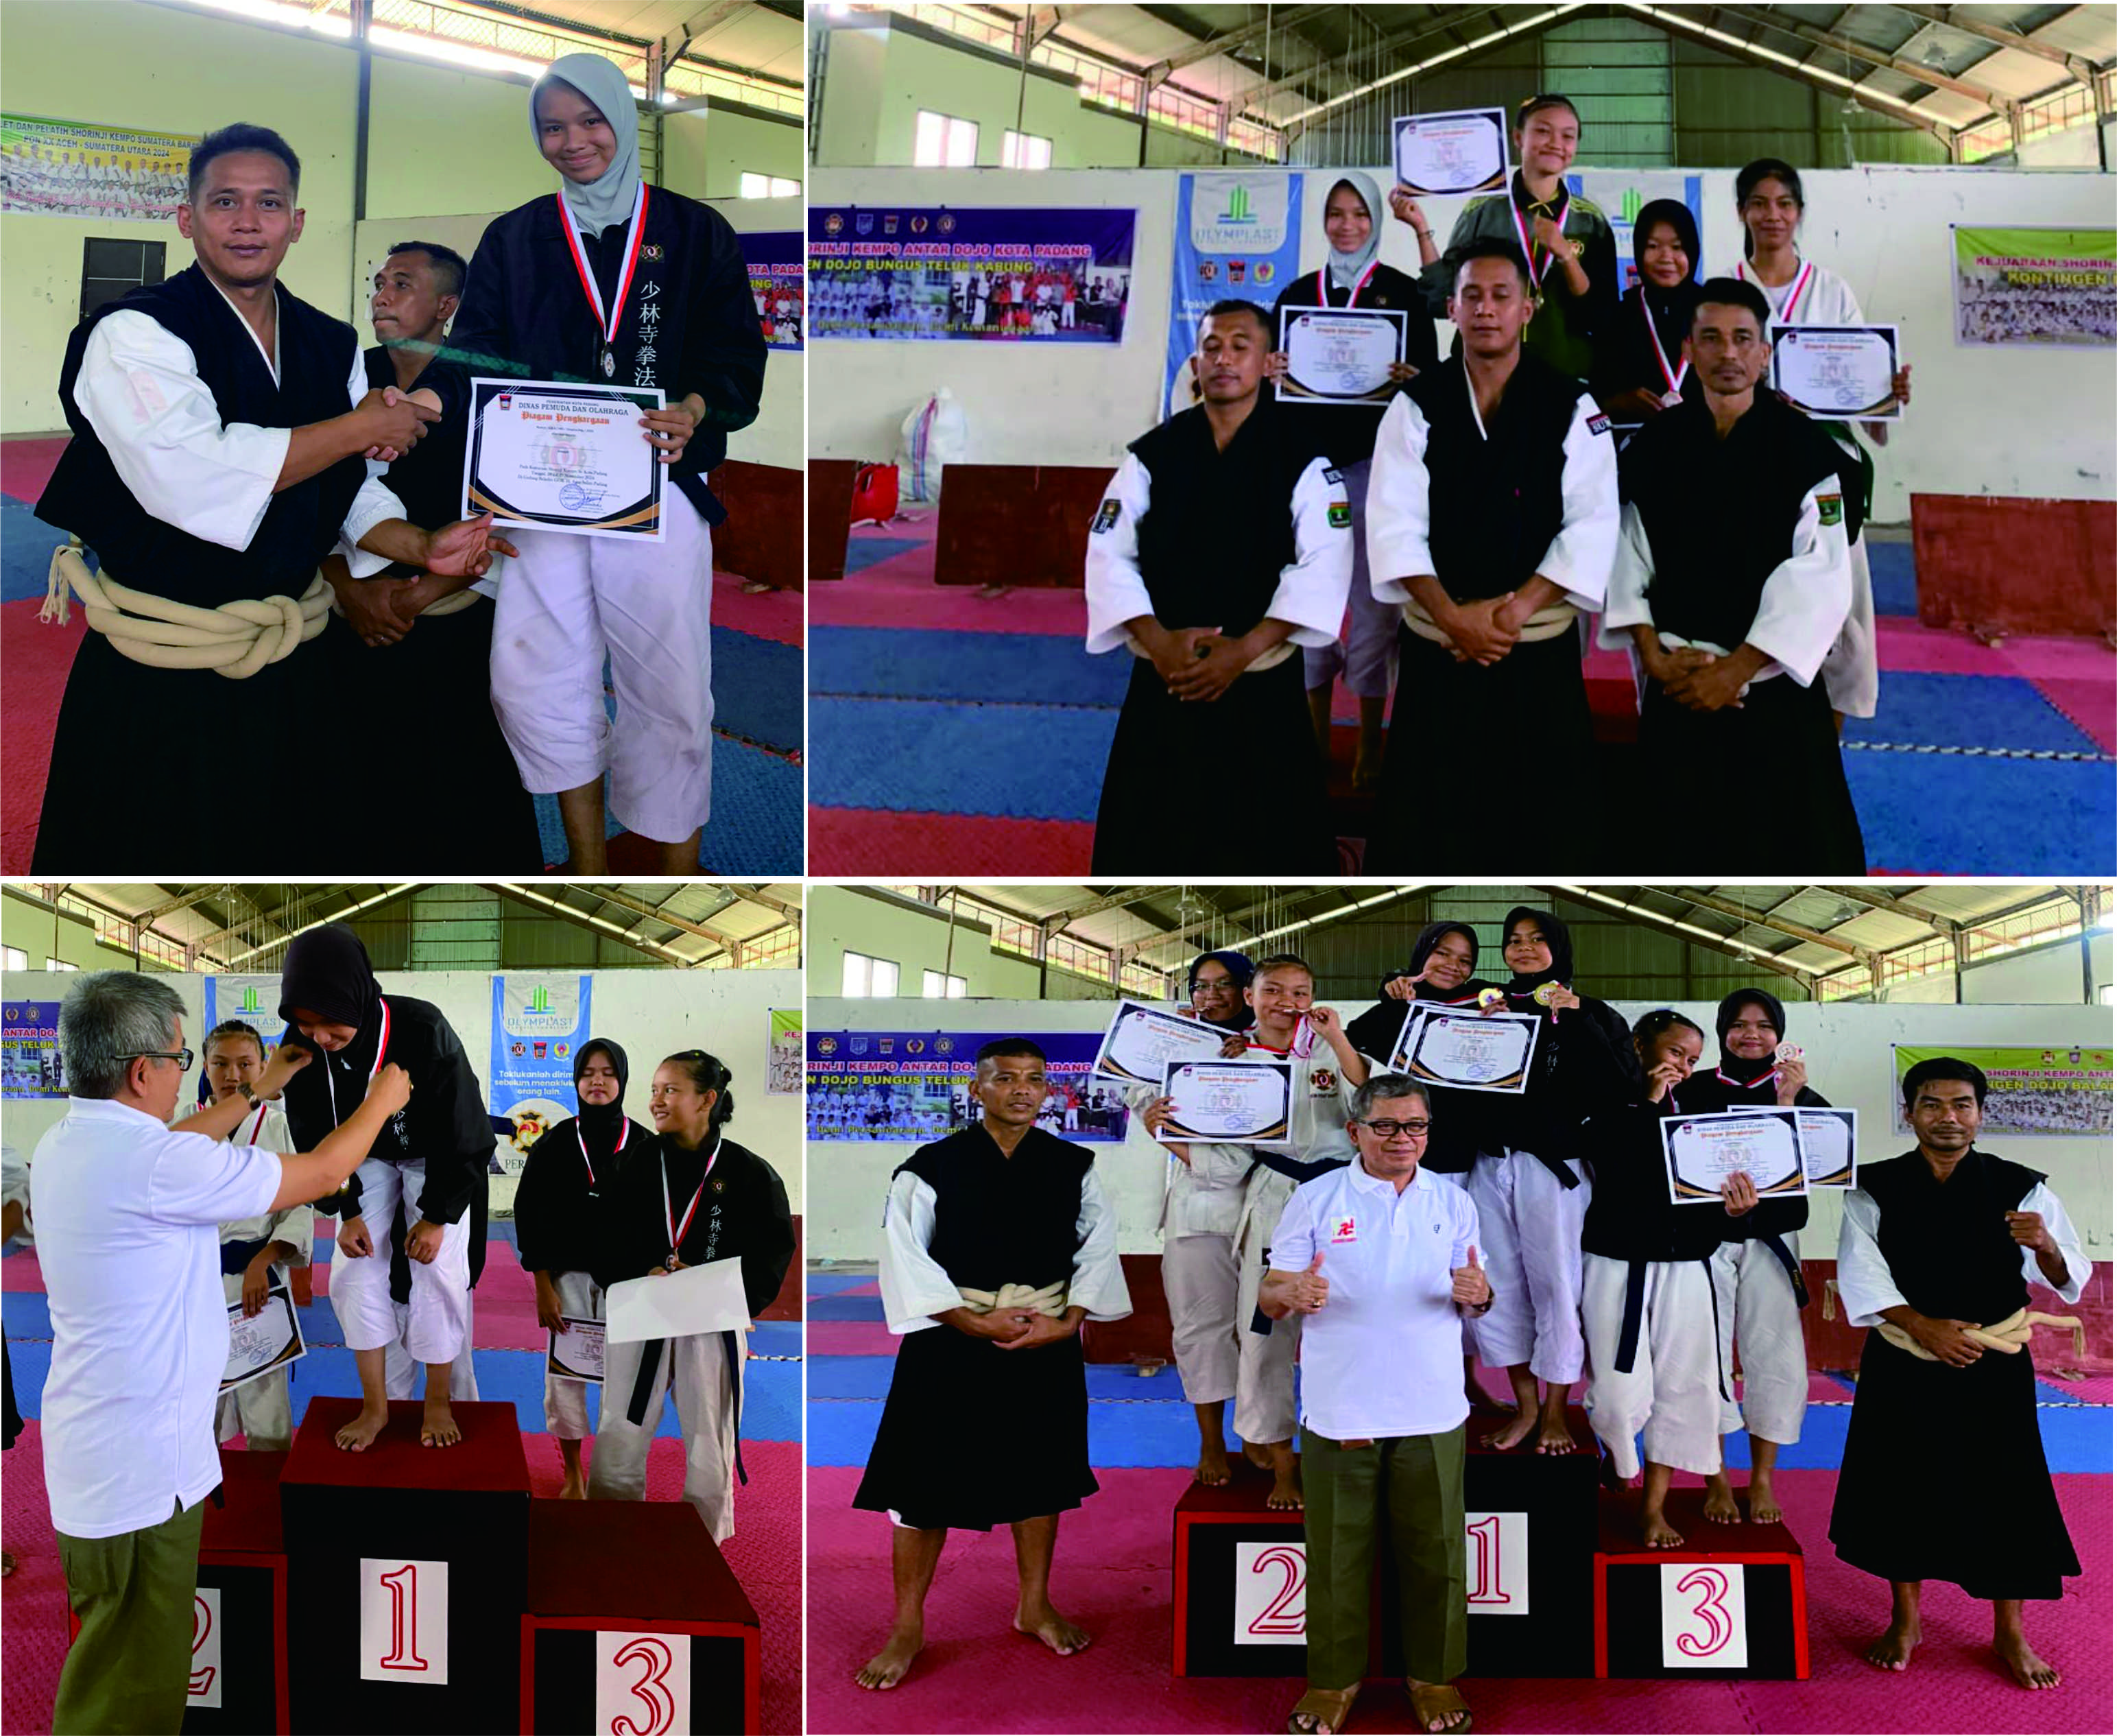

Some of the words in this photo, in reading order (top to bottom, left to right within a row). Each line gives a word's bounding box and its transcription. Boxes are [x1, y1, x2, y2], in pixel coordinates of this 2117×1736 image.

[16, 122, 33, 131] DAN
[36, 124, 69, 135] PELATIH
[71, 128, 107, 140] SHORINJI
[110, 131, 135, 143] KEMPO
[137, 136, 175, 147] SUMATERA
[56, 139, 77, 147] ACEH
[84, 141, 125, 152] SUMATERA
[128, 145, 151, 155] UTARA
[153, 148, 169, 157] 2024
[852, 242, 902, 256] KEMPO
[903, 243, 950, 256] ANTAR
[952, 243, 992, 256] DOJO
[994, 244, 1031, 257] KOTA
[1034, 244, 1092, 257] PADANG
[826, 259, 862, 270] DOJO
[865, 259, 922, 270] BUNGUS
[926, 260, 970, 271] TELUK
[974, 261, 1034, 272] KABUNG
[1976, 257, 2057, 267] KEJUARAAN
[2008, 272, 2107, 285] KONTINGEN
[634, 281, 660, 387] 少林寺拳法
[542, 403, 570, 412] PEMUDA
[589, 407, 629, 416] OLAHRAGA
[521, 411, 552, 420] Piagam
[555, 413, 610, 425] Penghargaan
[507, 1017, 573, 1026] OLYMPLAST
[3, 1028, 38, 1038] ANTAR
[22, 1041, 55, 1049] TELUK
[848, 1061, 898, 1072] KEMPO
[900, 1062, 950, 1073] ANTAR
[2044, 1069, 2083, 1078] KEMPO
[499, 1070, 550, 1078] Taklukanlah
[821, 1075, 859, 1084] DOJO
[863, 1075, 921, 1084] BUNGUS
[926, 1075, 971, 1085] TELUK
[2029, 1080, 2067, 1090] DOJO
[518, 1089, 542, 1097] orang
[505, 1159, 525, 1169] PER
[704, 1204, 722, 1261] 少林寺拳
[1466, 1517, 1510, 1604] 1
[1248, 1546, 1306, 1635] 2
[381, 1565, 428, 1670] 1
[1676, 1567, 1733, 1657] 3
[611, 1638, 675, 1736] 3
